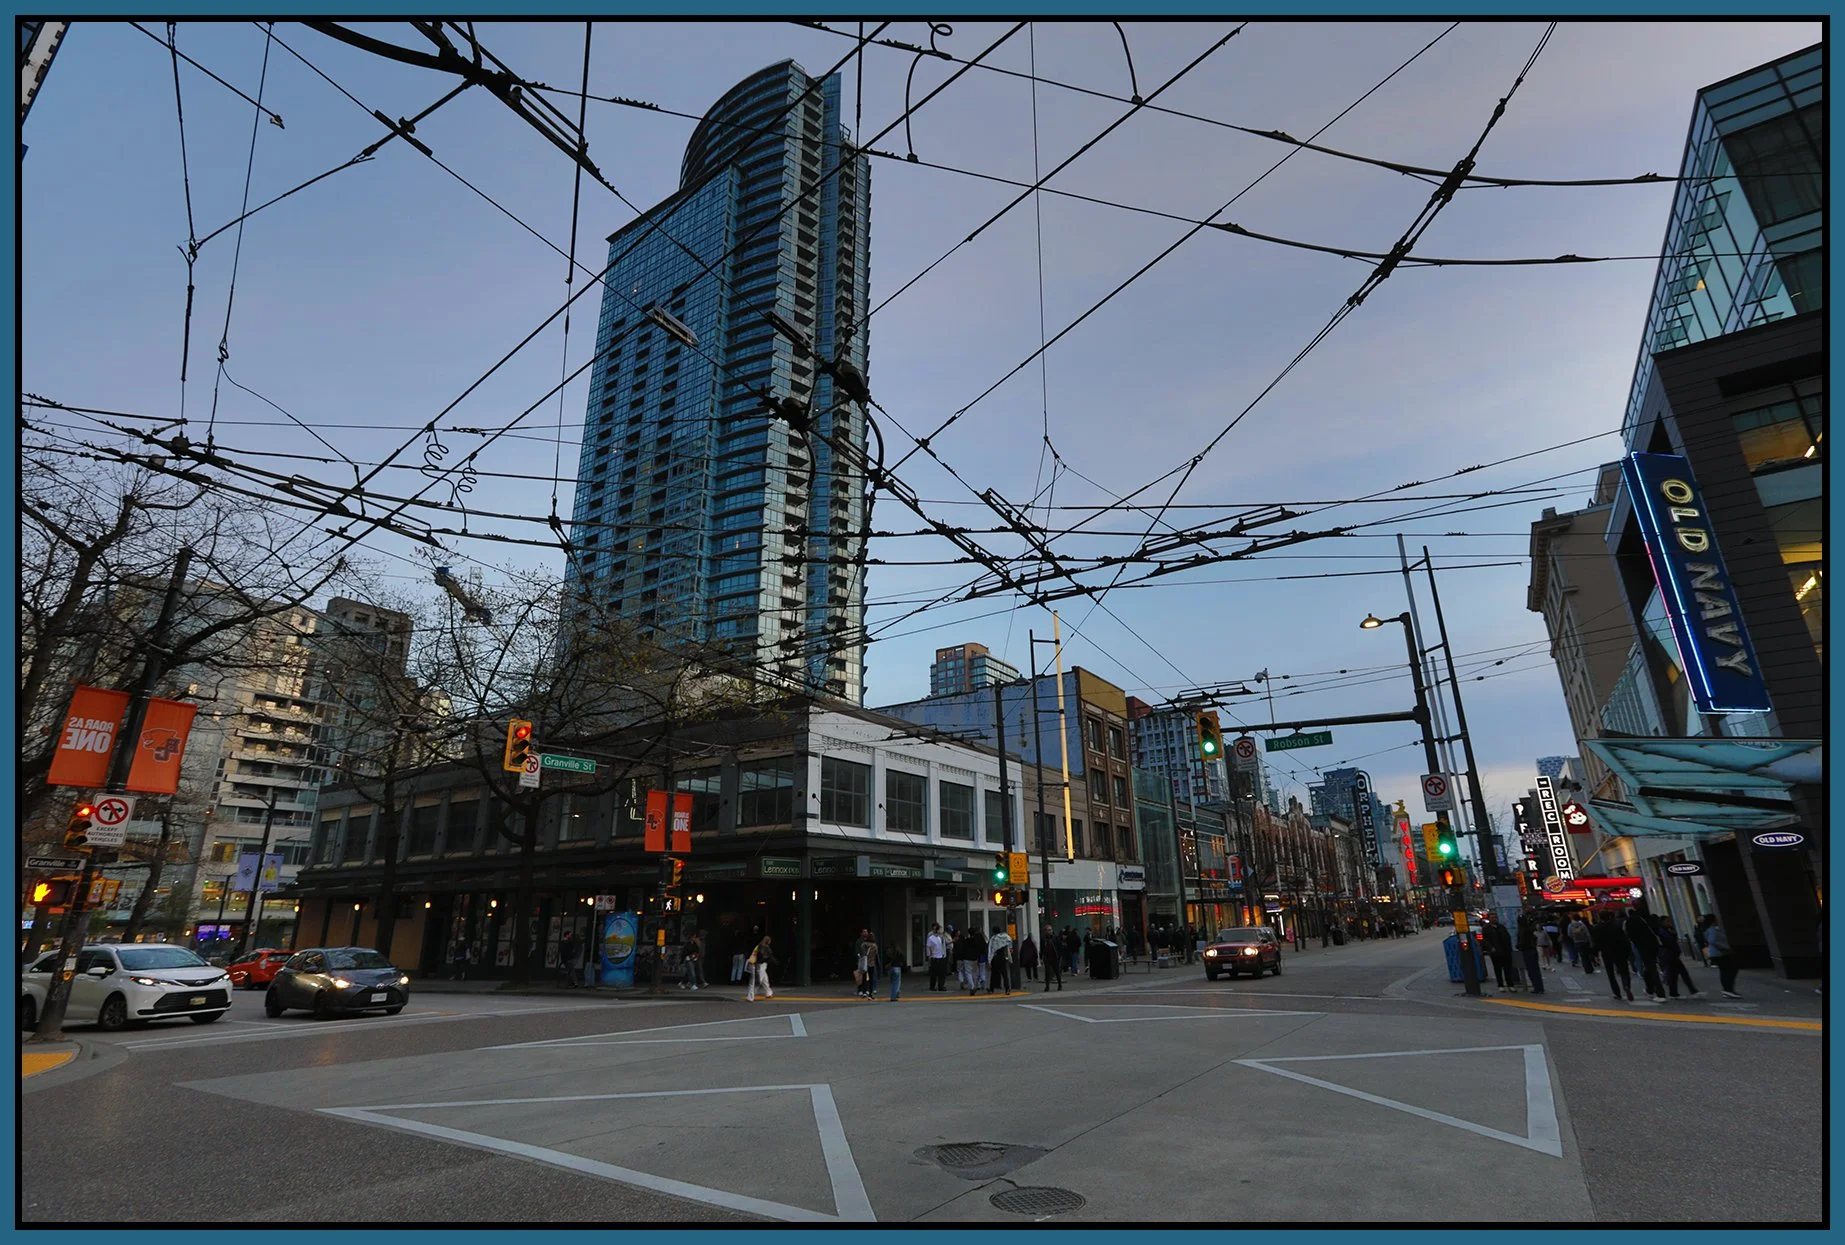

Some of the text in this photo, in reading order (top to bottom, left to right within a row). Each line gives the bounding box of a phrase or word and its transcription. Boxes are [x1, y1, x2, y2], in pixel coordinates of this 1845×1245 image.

[1660, 478, 1754, 678] OLD NAVY
[1273, 735, 1324, 750] Robson St
[544, 756, 592, 771] Granville St
[673, 818, 689, 832] ONE
[1357, 779, 1379, 867] ORPHEUM
[1541, 790, 1556, 821] REC
[1552, 835, 1571, 880] ROOM
[1758, 835, 1798, 844] OLD NAVY
[29, 859, 66, 867] Granville
